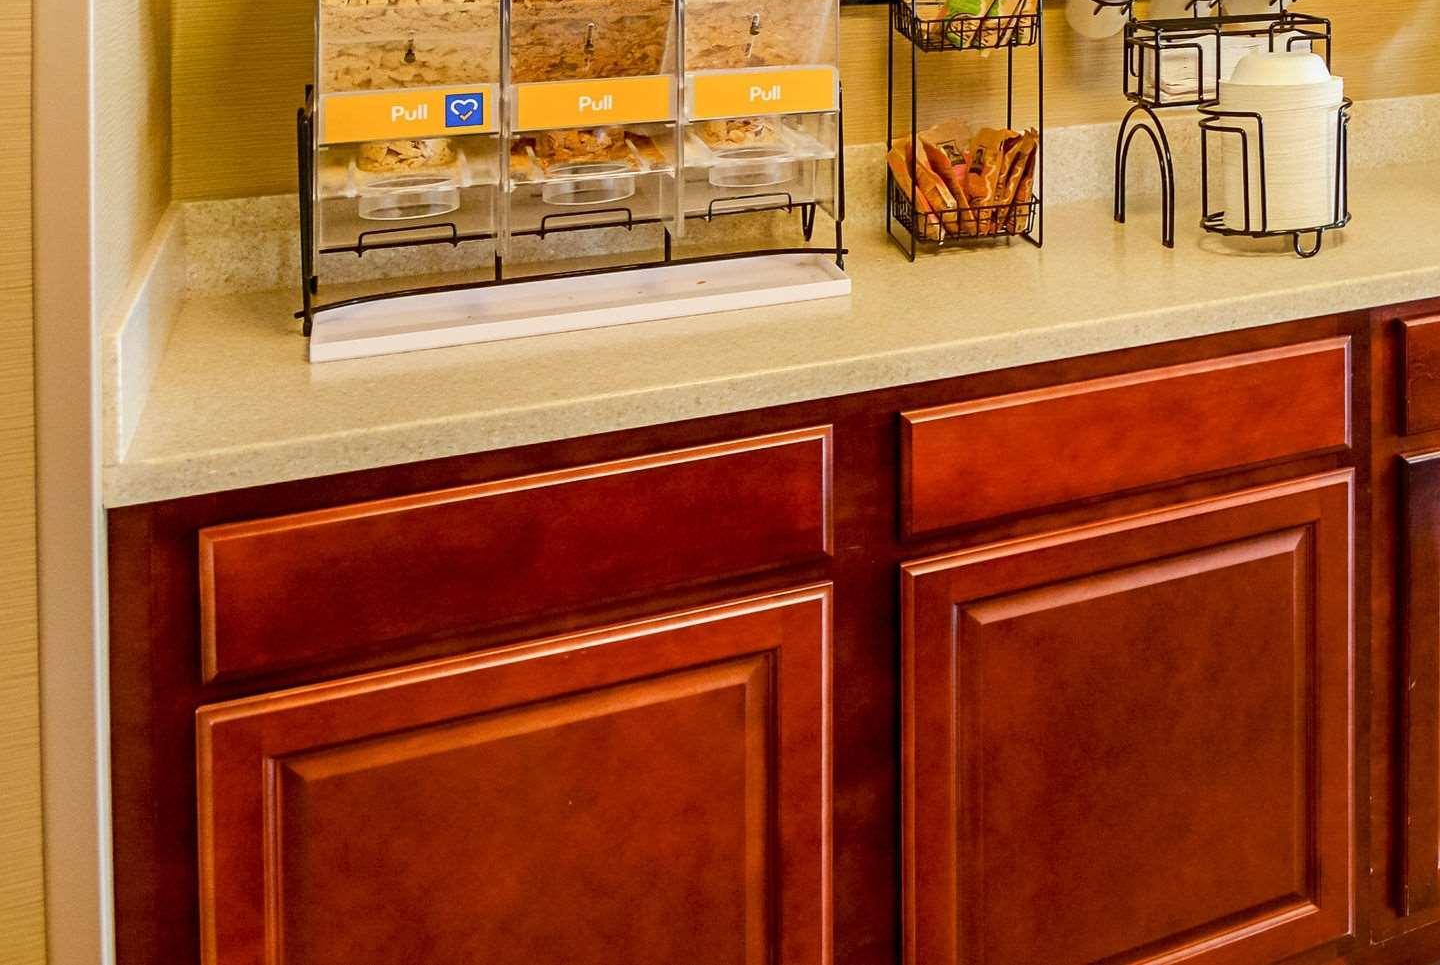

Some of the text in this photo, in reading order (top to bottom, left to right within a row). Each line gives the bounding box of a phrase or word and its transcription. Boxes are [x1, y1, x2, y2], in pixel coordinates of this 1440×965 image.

[749, 84, 781, 103] Pull
[391, 103, 428, 123] Pull
[578, 94, 613, 114] Pull
